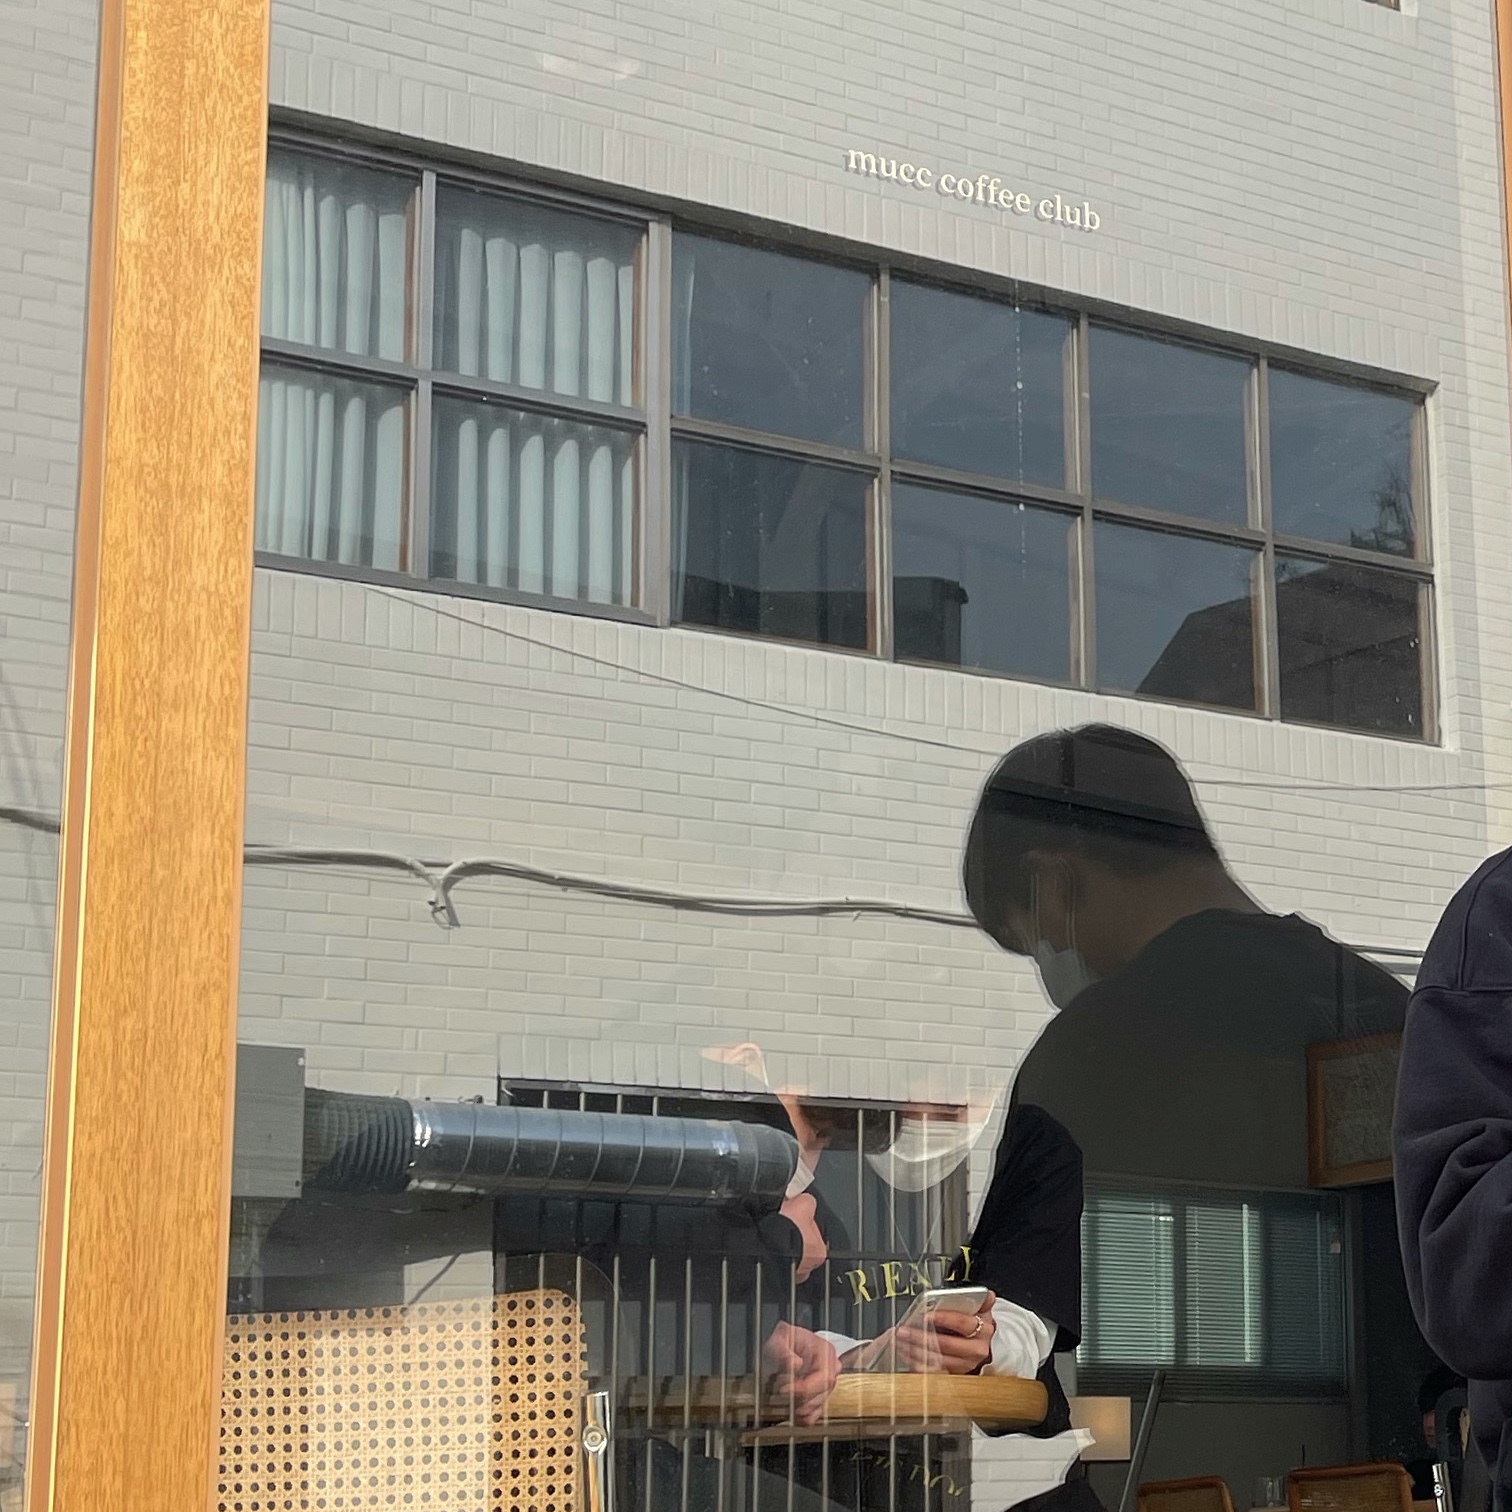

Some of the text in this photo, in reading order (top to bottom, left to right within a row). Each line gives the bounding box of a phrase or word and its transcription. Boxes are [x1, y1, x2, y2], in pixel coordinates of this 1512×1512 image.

[847, 149, 1101, 231] mucc coffee club
